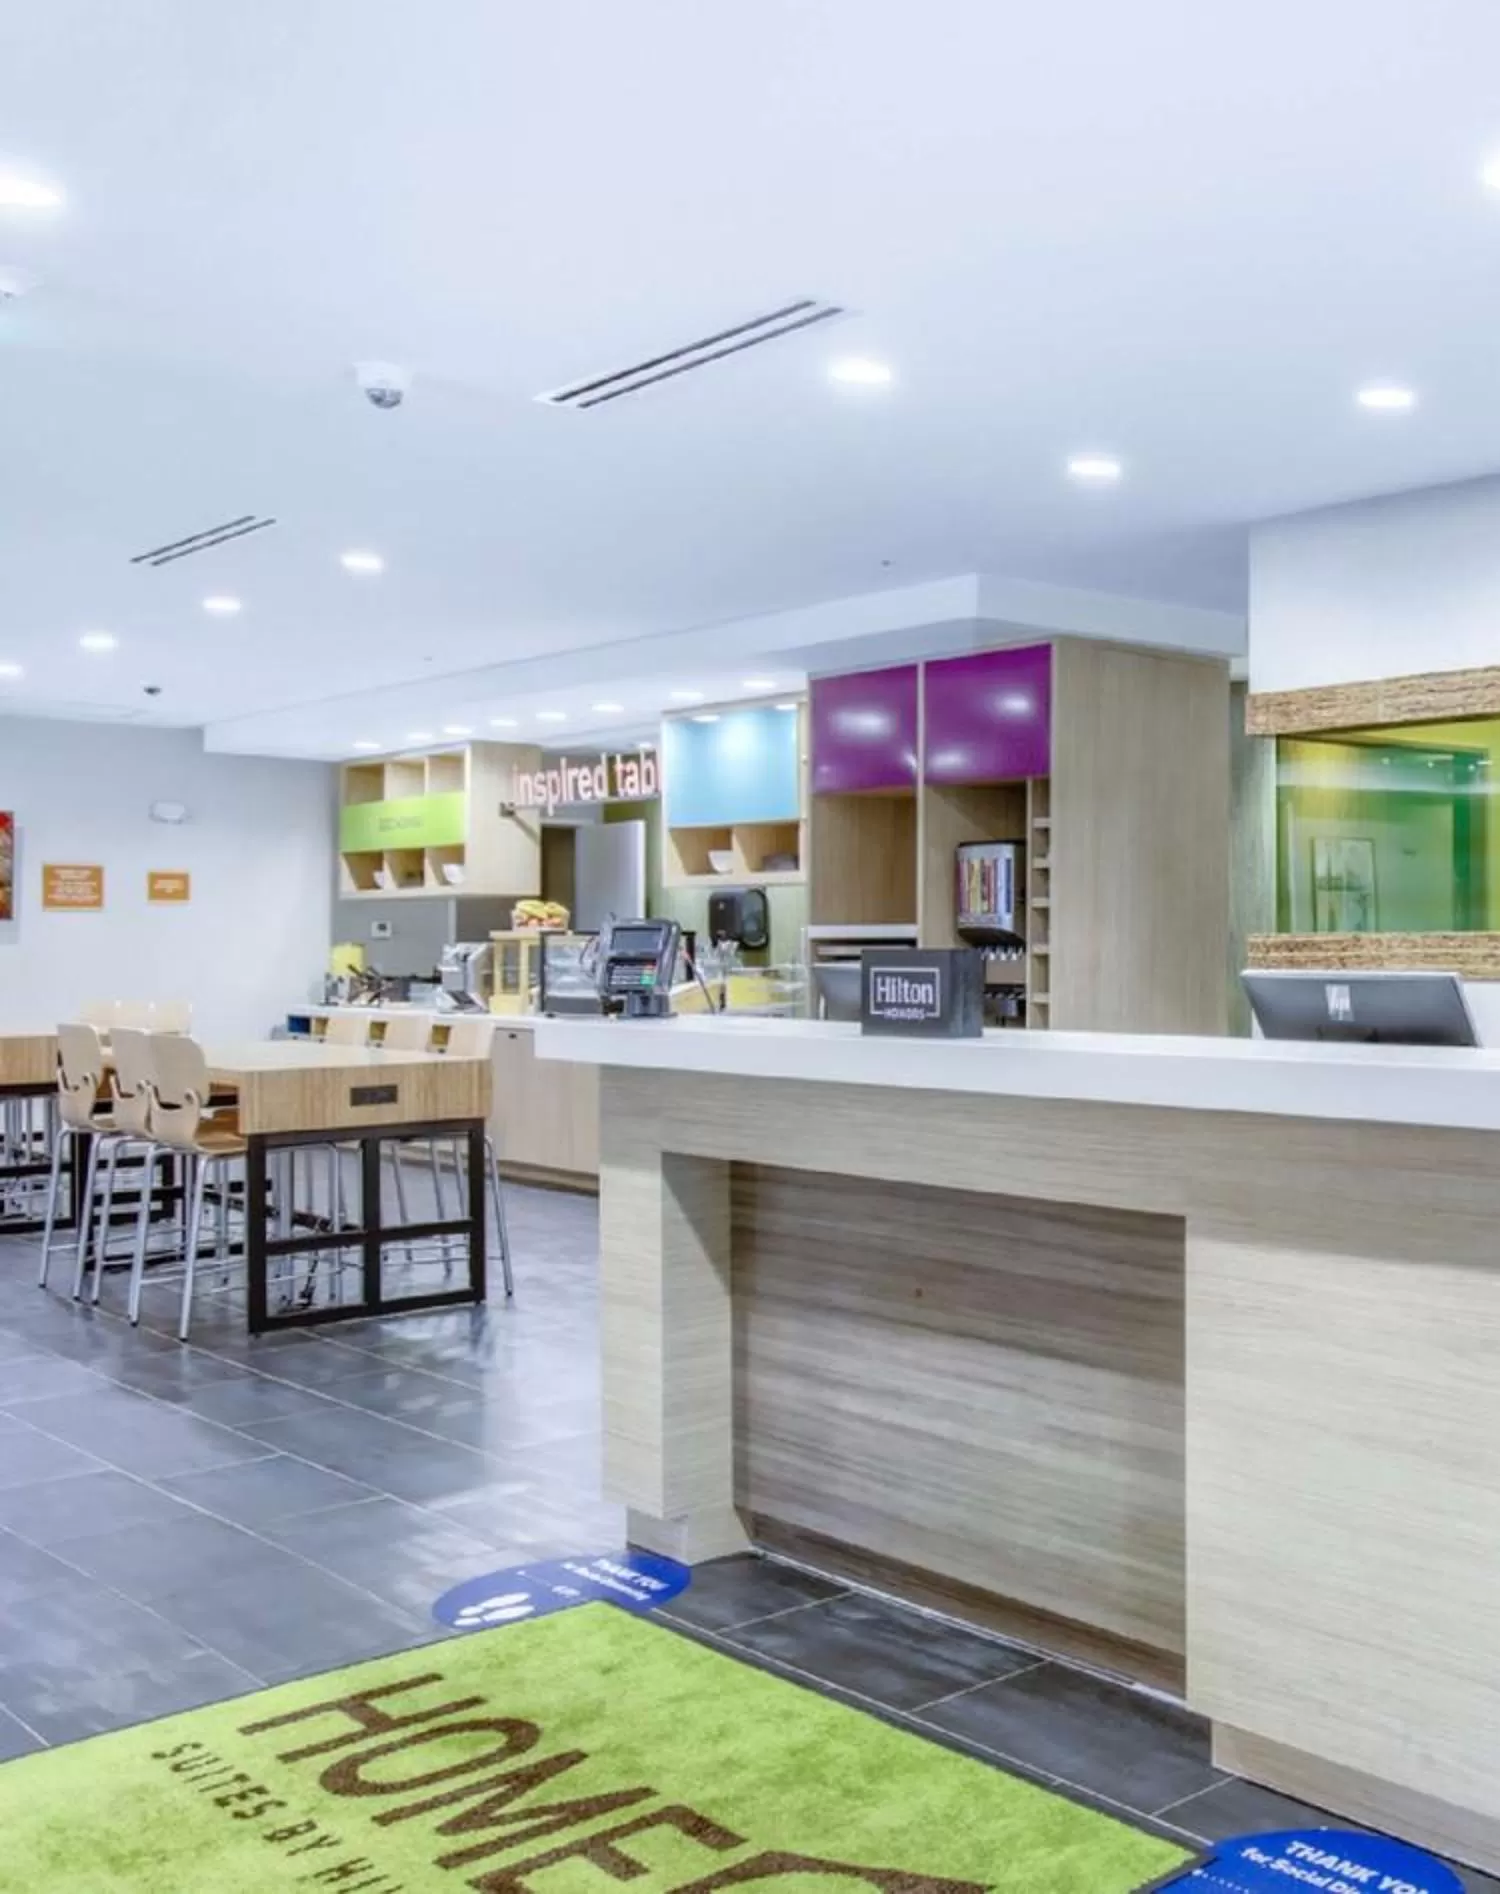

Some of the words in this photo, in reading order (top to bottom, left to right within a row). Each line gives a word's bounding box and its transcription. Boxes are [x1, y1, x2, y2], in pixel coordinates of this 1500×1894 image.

[511, 752, 610, 816] inspired
[614, 748, 662, 797] tabl
[875, 975, 934, 1005] Hilton
[151, 1740, 288, 1821] SUITES
[262, 1818, 342, 1857] BY
[1269, 1858, 1333, 1888] Social
[1285, 1840, 1380, 1884] THANK
